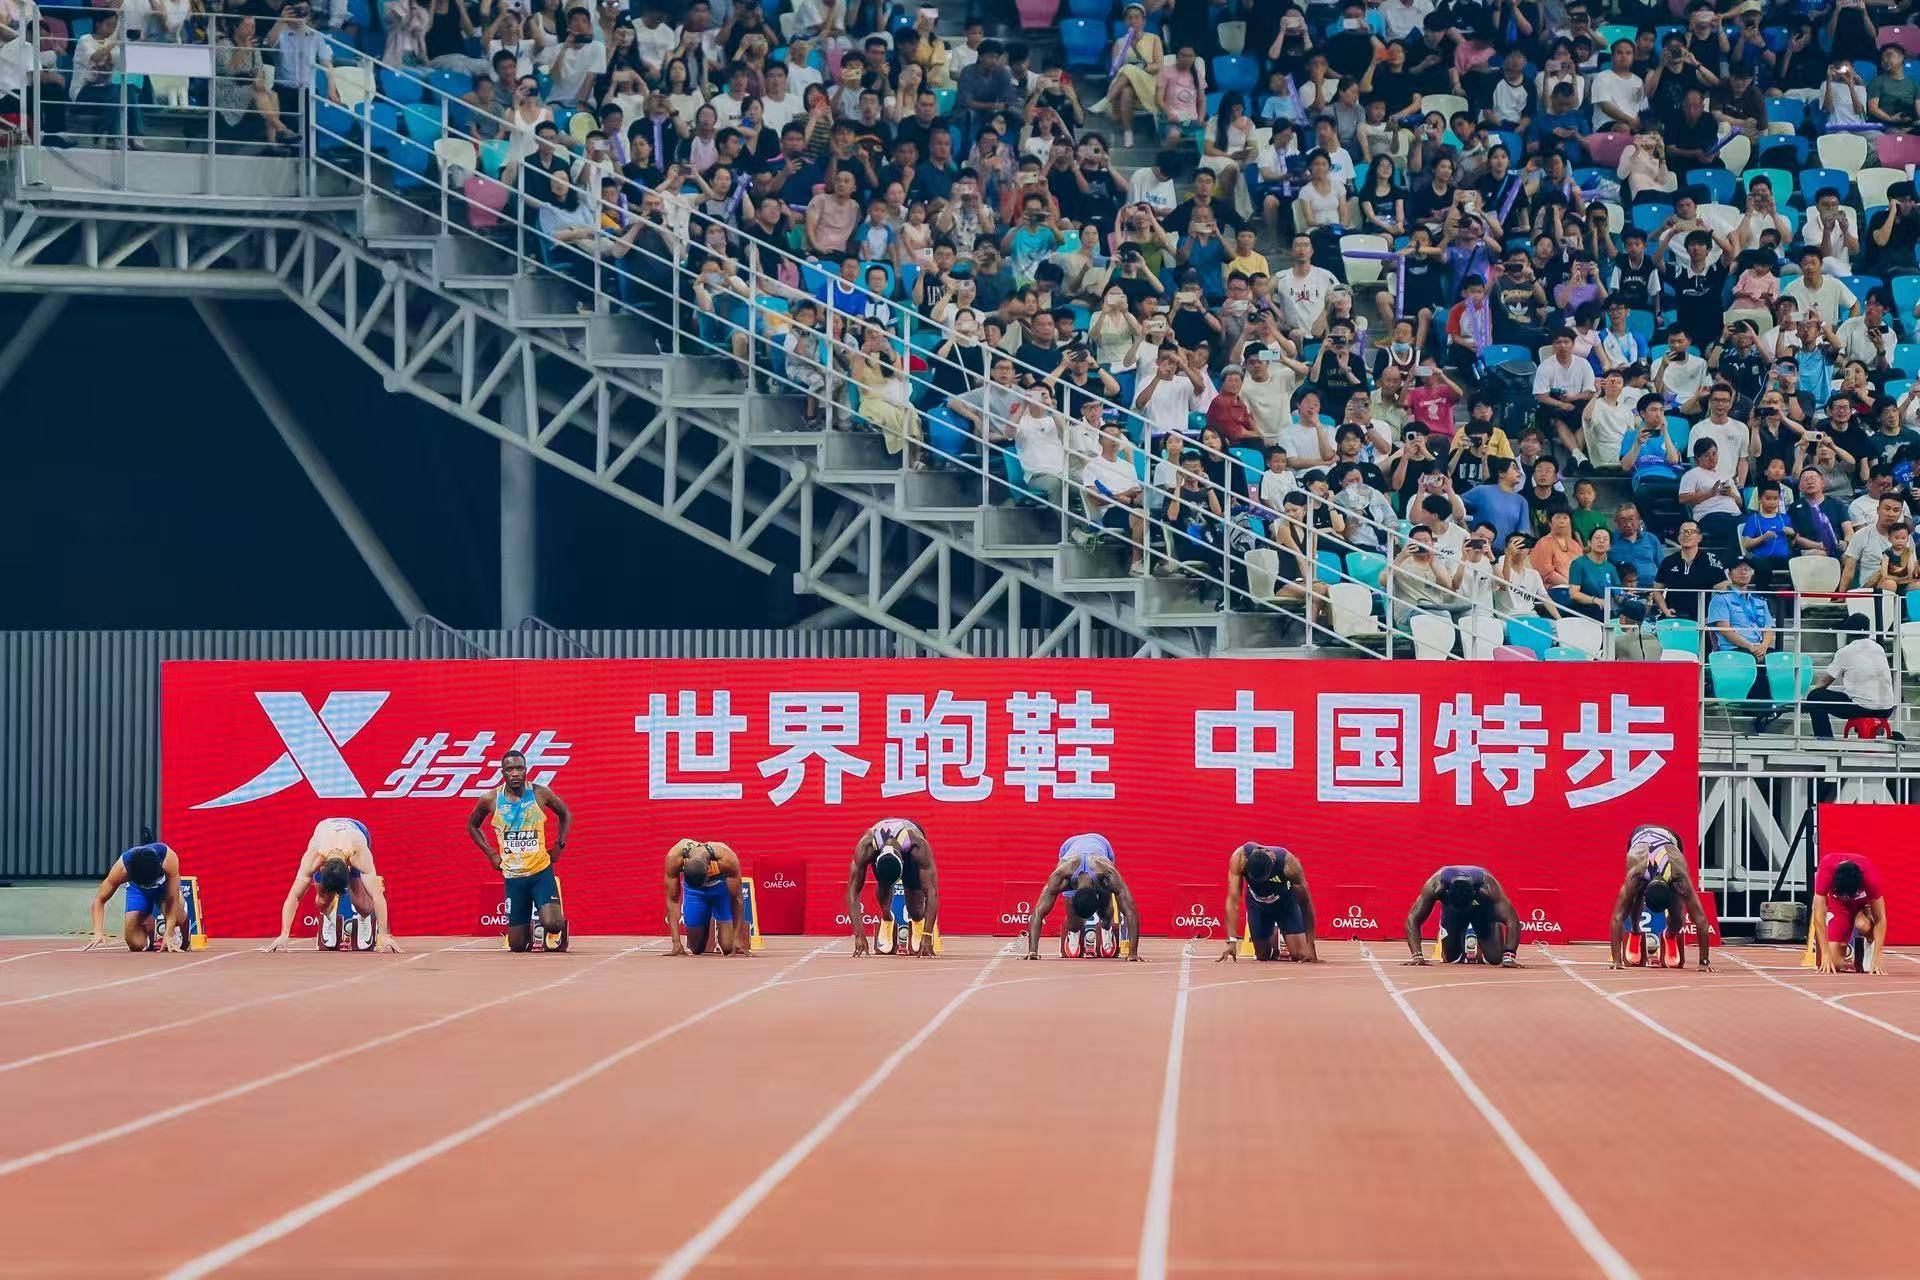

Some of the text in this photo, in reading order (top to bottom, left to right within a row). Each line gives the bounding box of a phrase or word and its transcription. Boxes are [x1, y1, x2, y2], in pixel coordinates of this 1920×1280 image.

[634, 690, 1675, 808] 世界跑鞋 中国特步
[763, 880, 797, 889] OMEGA
[835, 914, 880, 925] OMGA
[1175, 916, 1221, 927] OMEGA
[1332, 917, 1379, 929] OMEGA
[1638, 911, 1652, 933] 2
[1679, 924, 1716, 935] MEA
